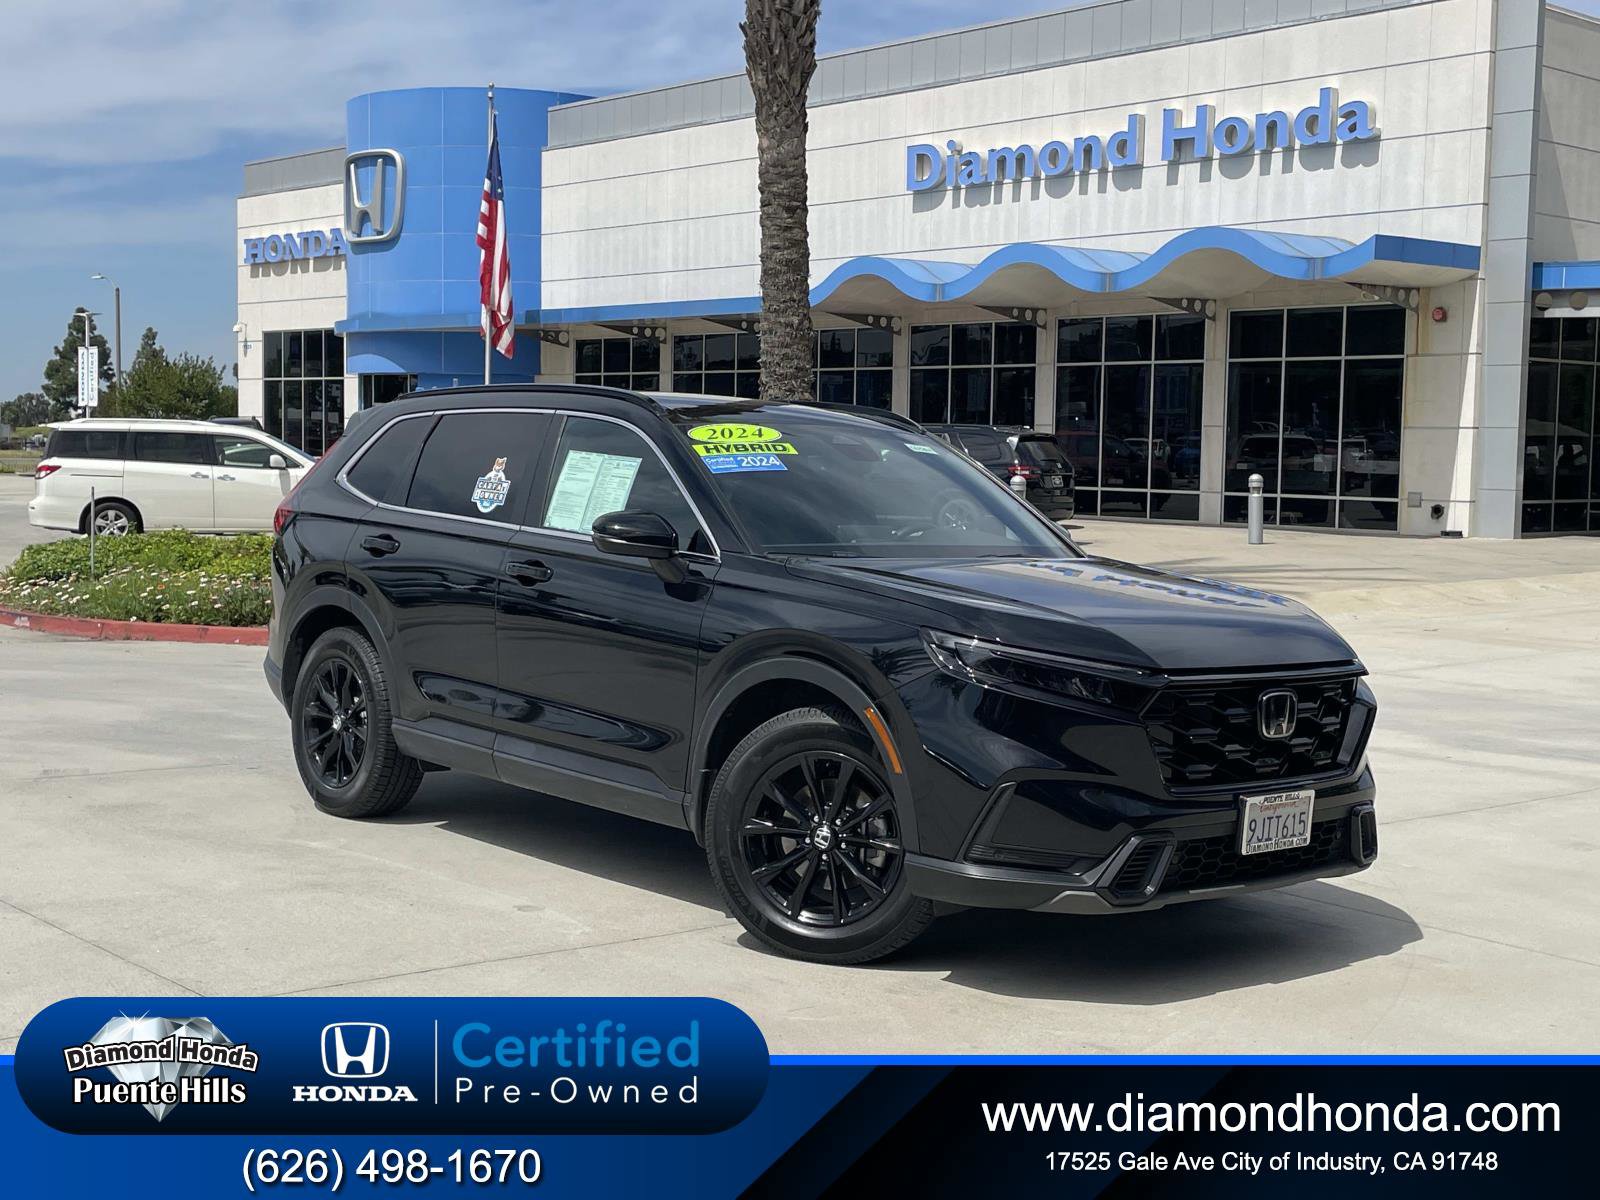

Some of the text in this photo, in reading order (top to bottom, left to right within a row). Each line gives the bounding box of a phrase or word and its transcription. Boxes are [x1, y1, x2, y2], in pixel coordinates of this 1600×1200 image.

[906, 86, 1381, 192] Diamond Honda
[244, 228, 347, 264] HONDA
[705, 427, 764, 440] 2024
[703, 443, 787, 454] HYBRID
[737, 456, 780, 467] 2024
[1247, 811, 1307, 844] 9JIT615
